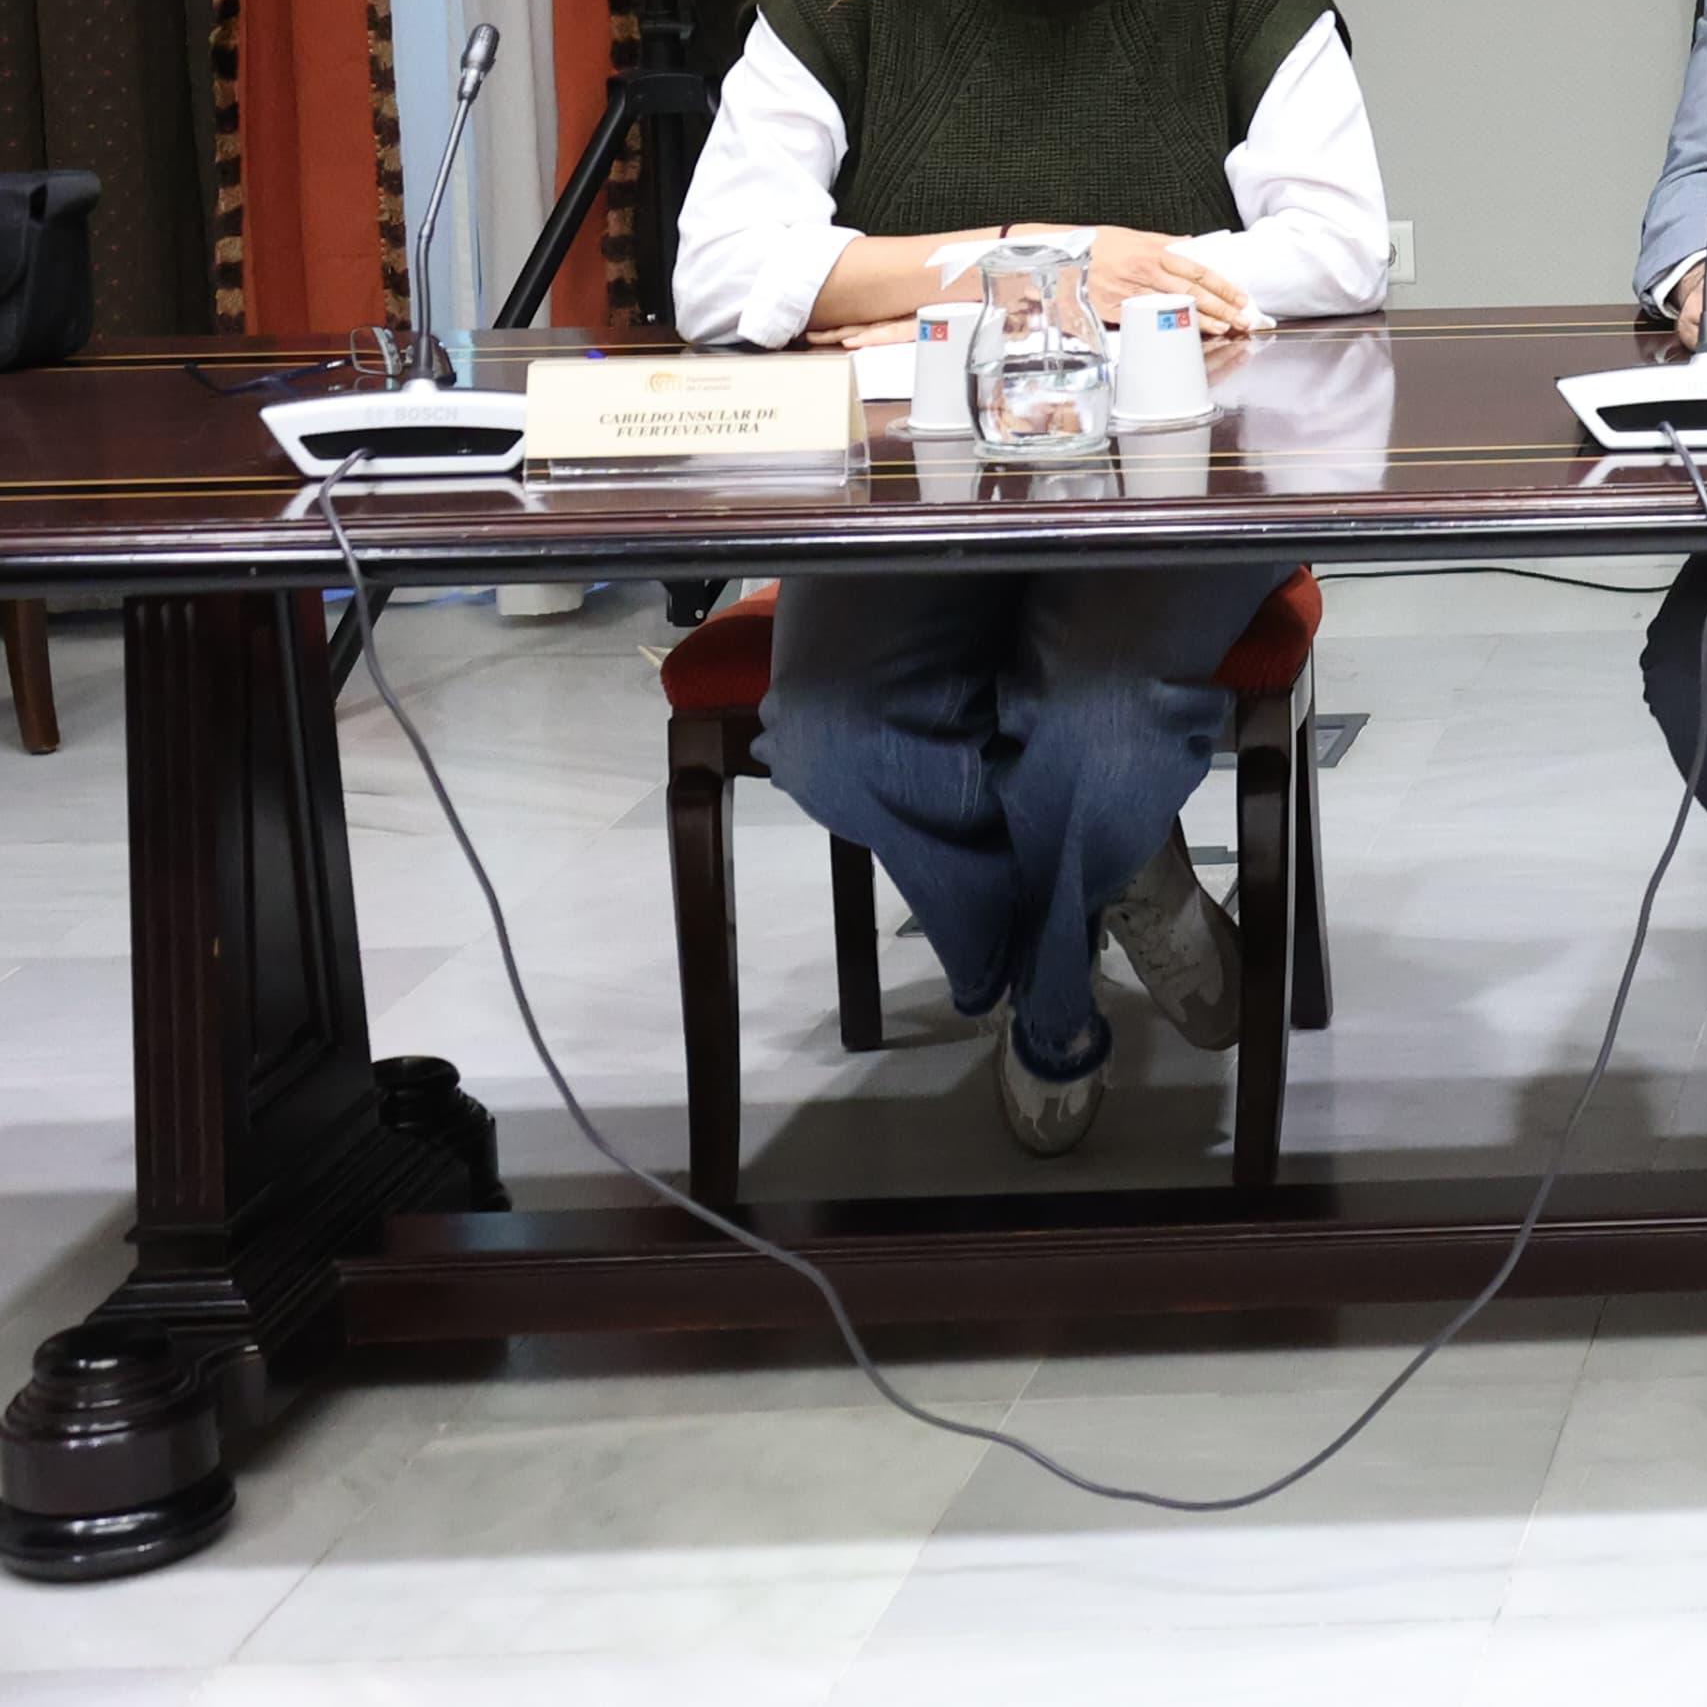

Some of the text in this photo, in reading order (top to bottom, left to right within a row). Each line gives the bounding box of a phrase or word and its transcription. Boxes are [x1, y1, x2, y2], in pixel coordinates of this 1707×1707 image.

[395, 405, 459, 422] BOSCH
[599, 408, 778, 425] CABILDO INSULAR DE
[616, 422, 760, 438] FUERTEVENTURA
